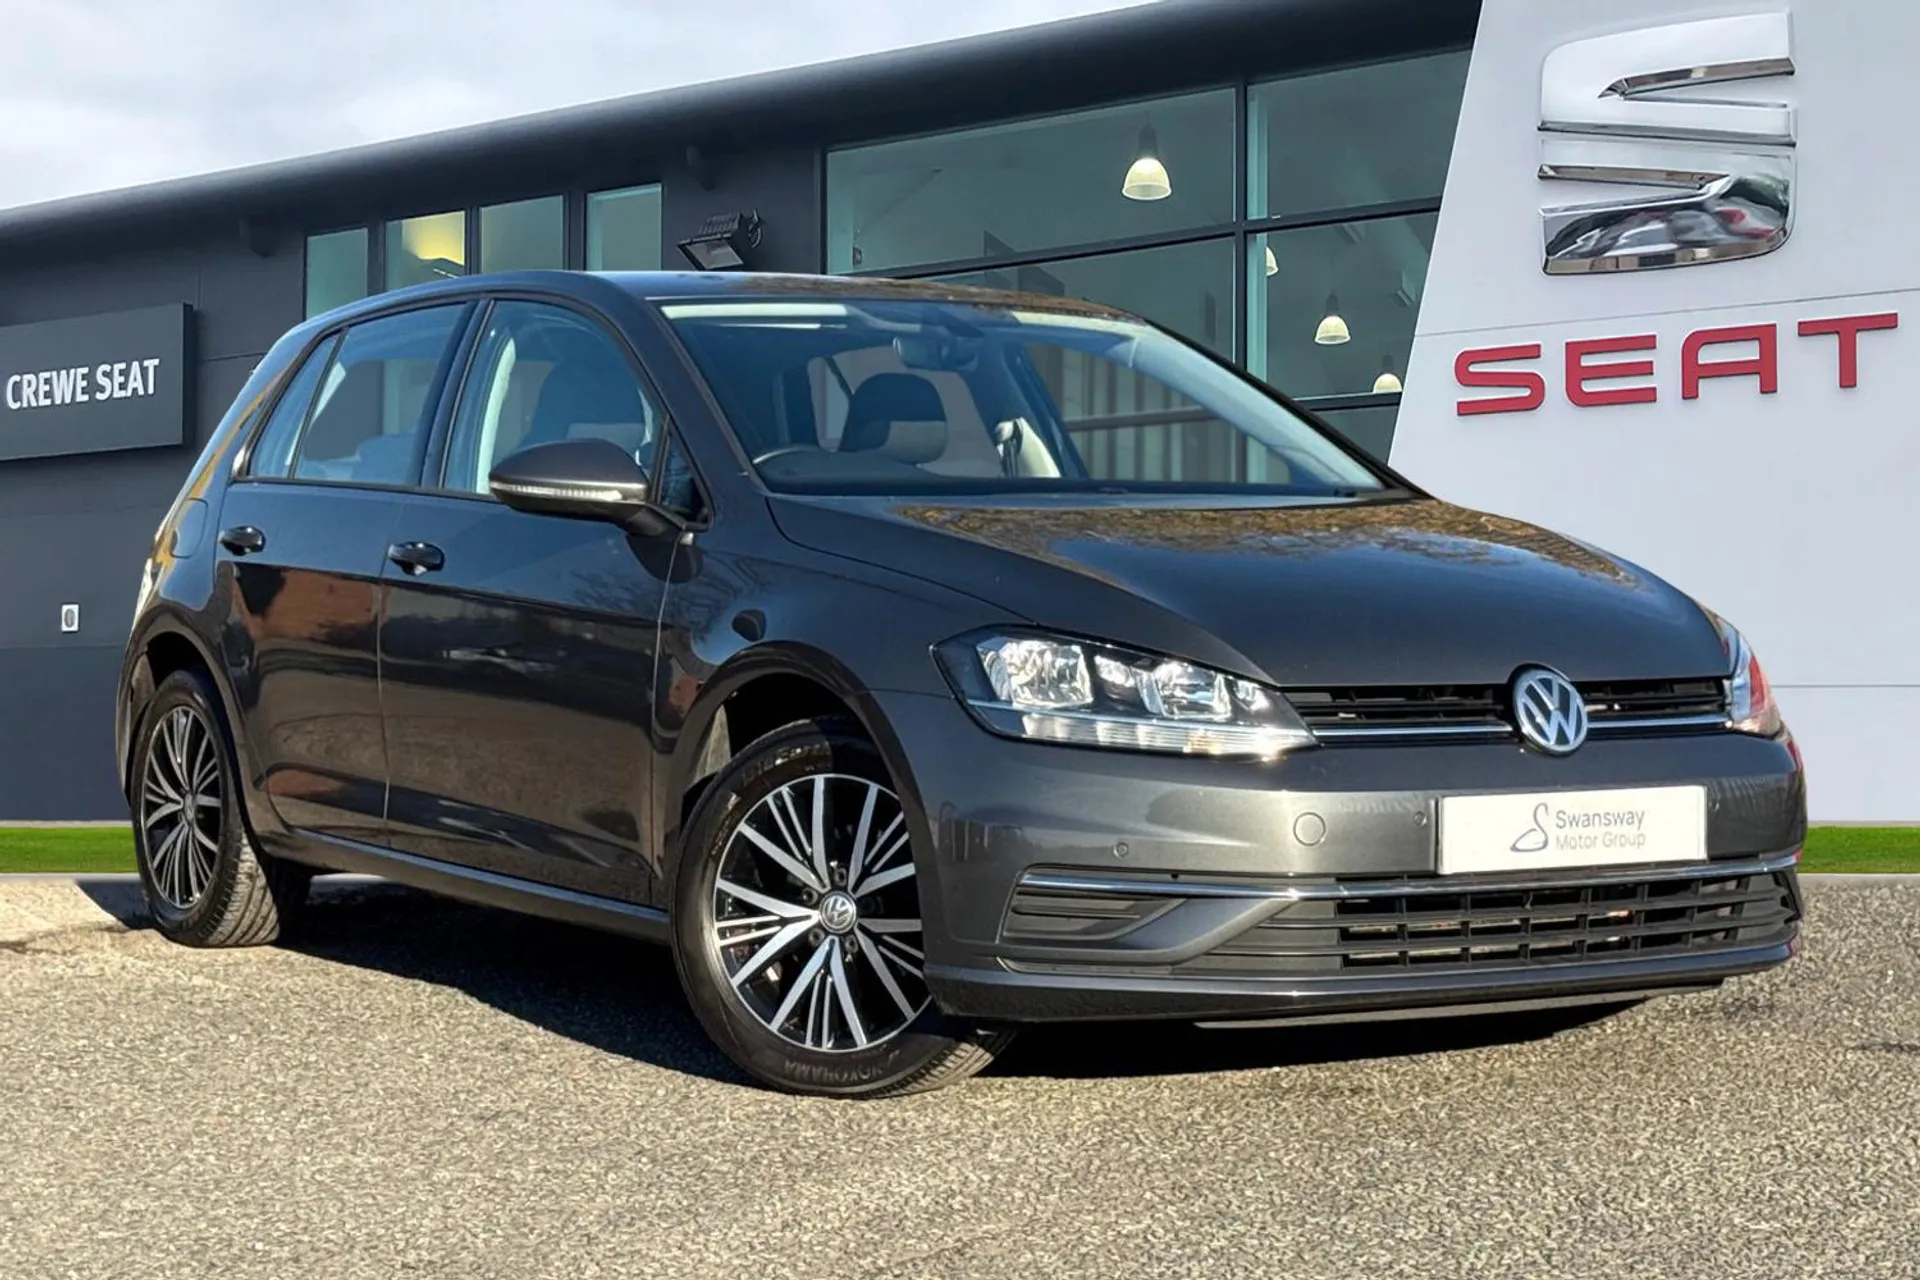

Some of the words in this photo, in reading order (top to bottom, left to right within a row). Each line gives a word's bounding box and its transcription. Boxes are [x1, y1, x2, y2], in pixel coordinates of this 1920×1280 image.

[1454, 312, 1899, 417] SEAT
[6, 366, 90, 410] CREWE
[94, 358, 160, 401] SEAT
[1555, 809, 1645, 832] Swansway
[1555, 834, 1598, 850] Motor
[1602, 831, 1647, 849] Group
